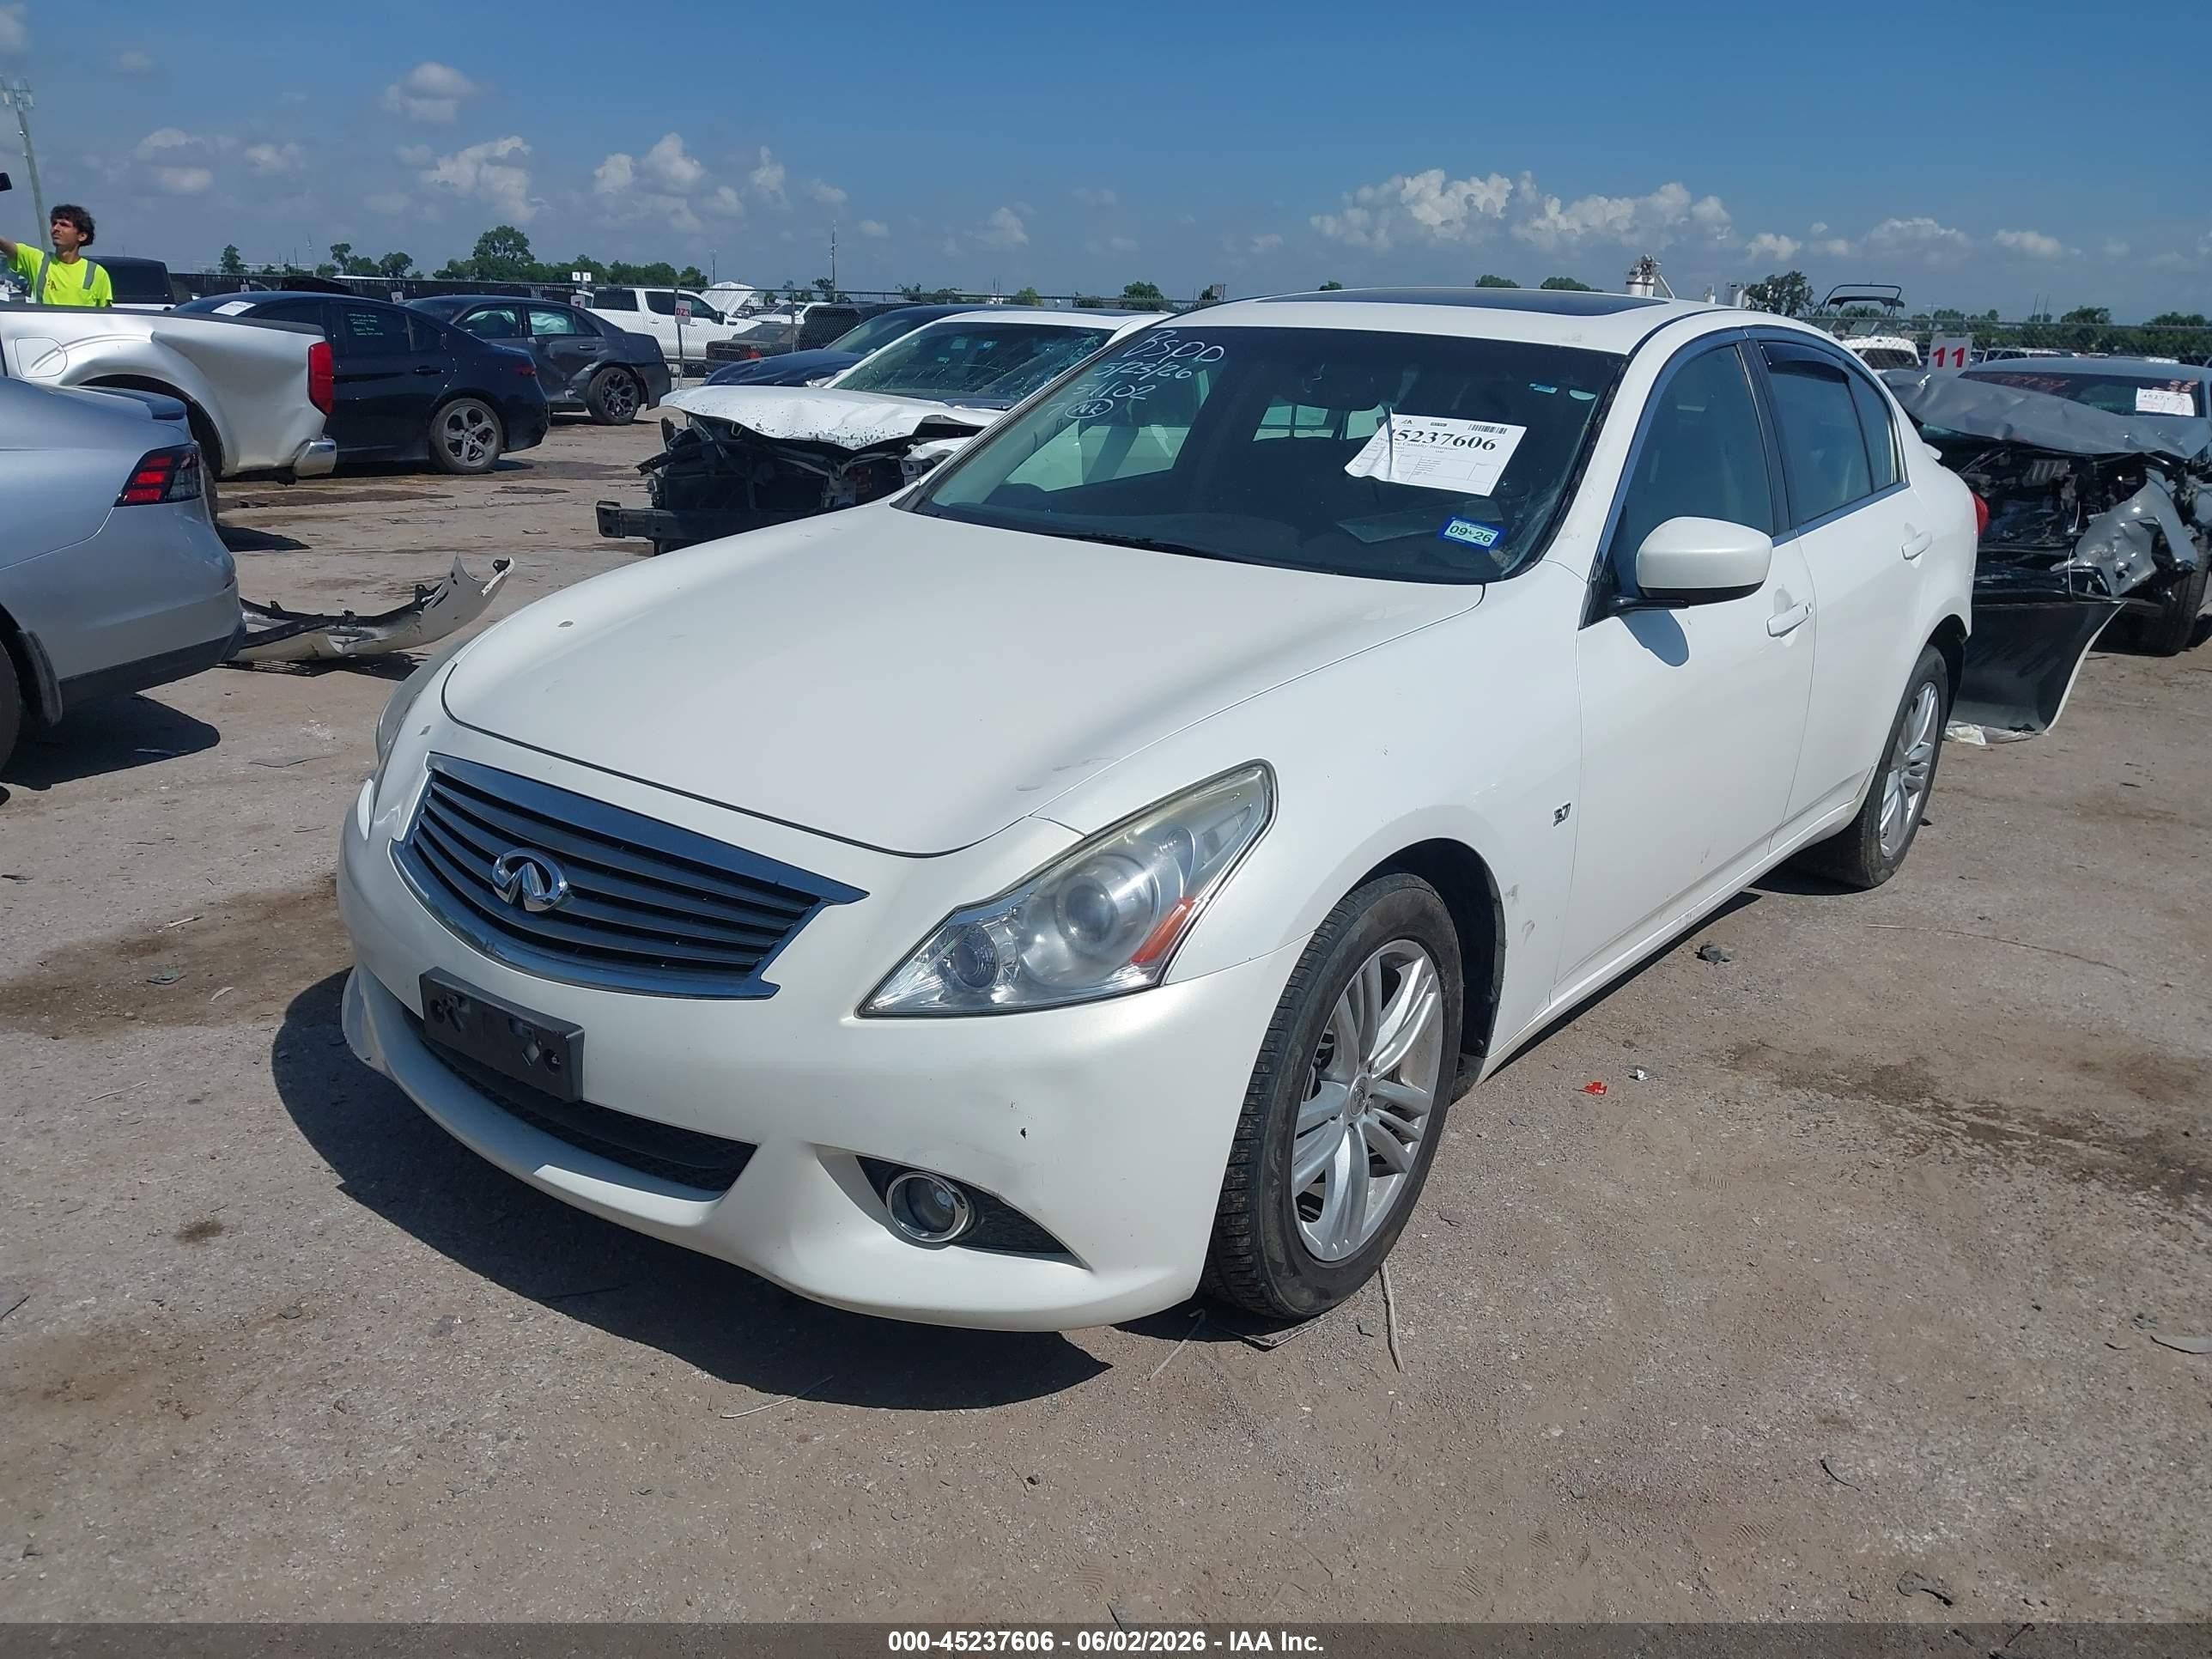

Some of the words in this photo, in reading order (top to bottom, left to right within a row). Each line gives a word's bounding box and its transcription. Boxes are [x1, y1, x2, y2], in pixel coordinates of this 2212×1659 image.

[1932, 347, 1966, 368] 11
[1094, 360, 1193, 380] 5/23/26
[1391, 428, 1500, 452] 5237606
